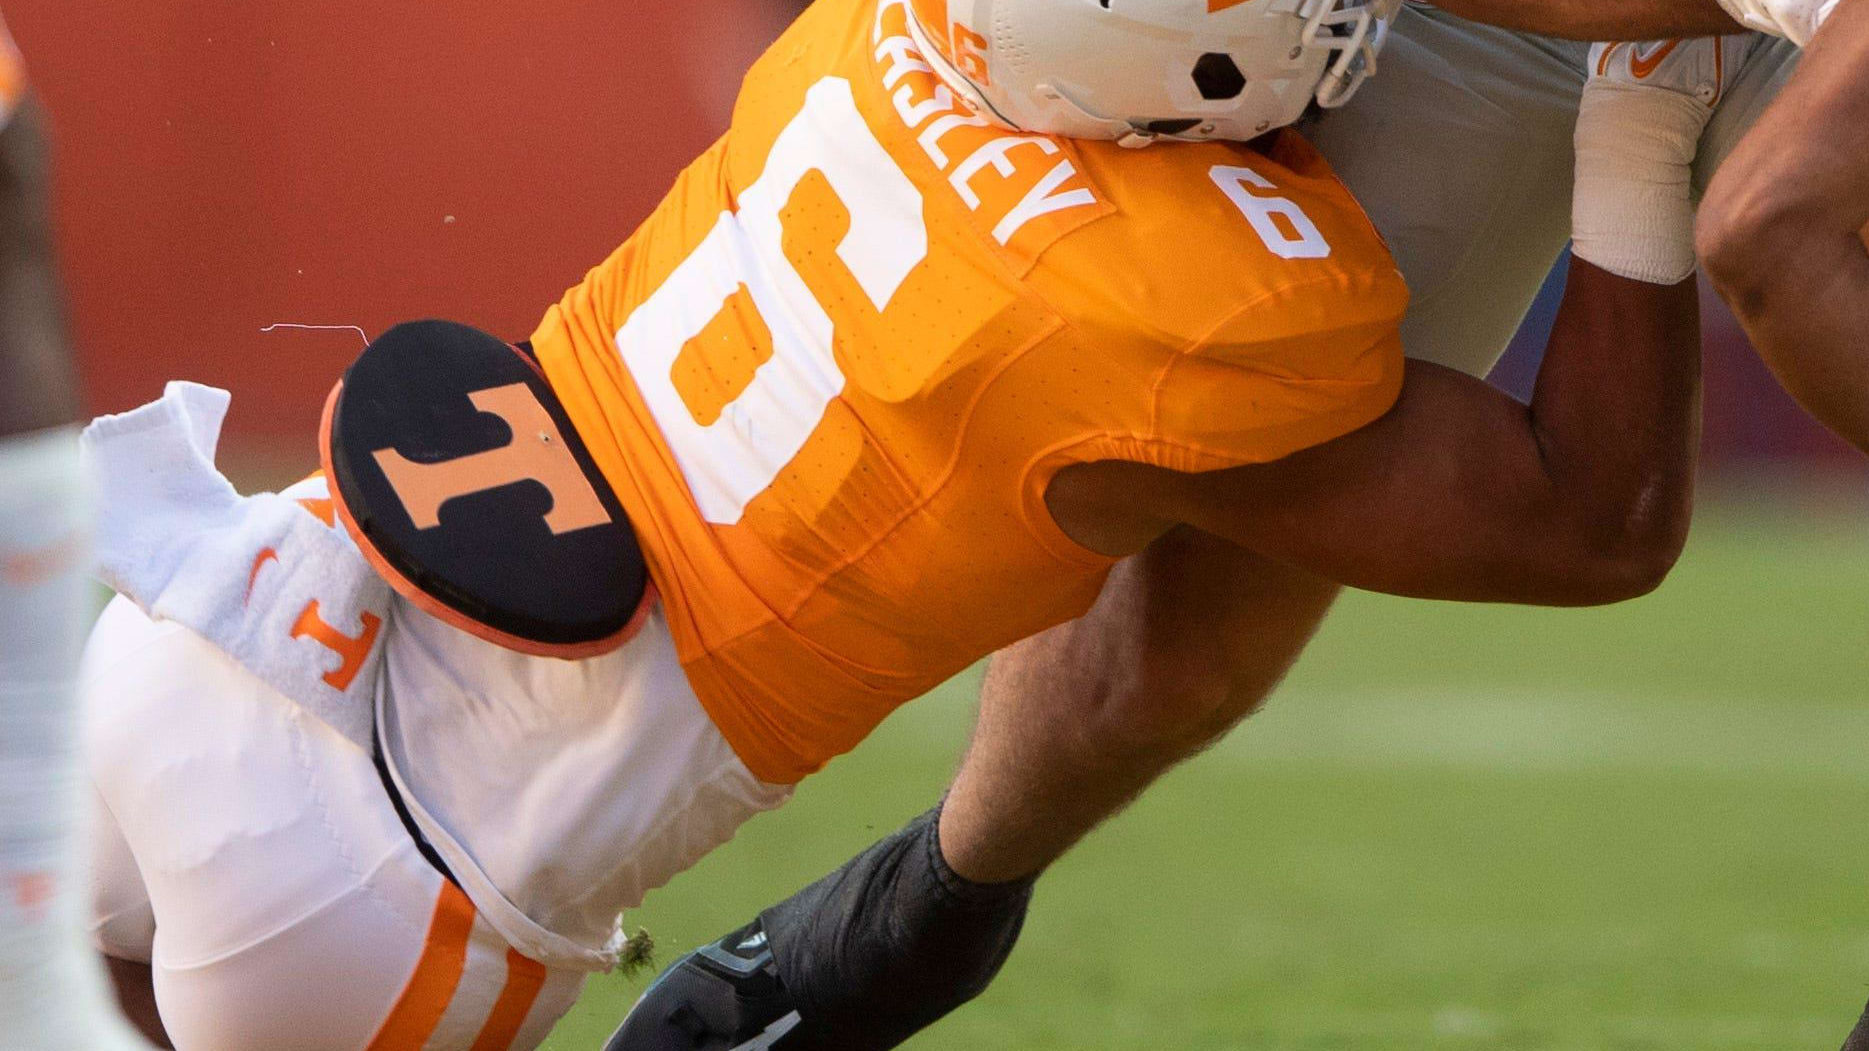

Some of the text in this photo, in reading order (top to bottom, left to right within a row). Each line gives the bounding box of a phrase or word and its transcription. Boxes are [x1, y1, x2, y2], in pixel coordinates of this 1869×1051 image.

[1208, 164, 1331, 259] 6
[615, 75, 928, 525] 6
[371, 381, 612, 535] T
[290, 598, 382, 692] T
